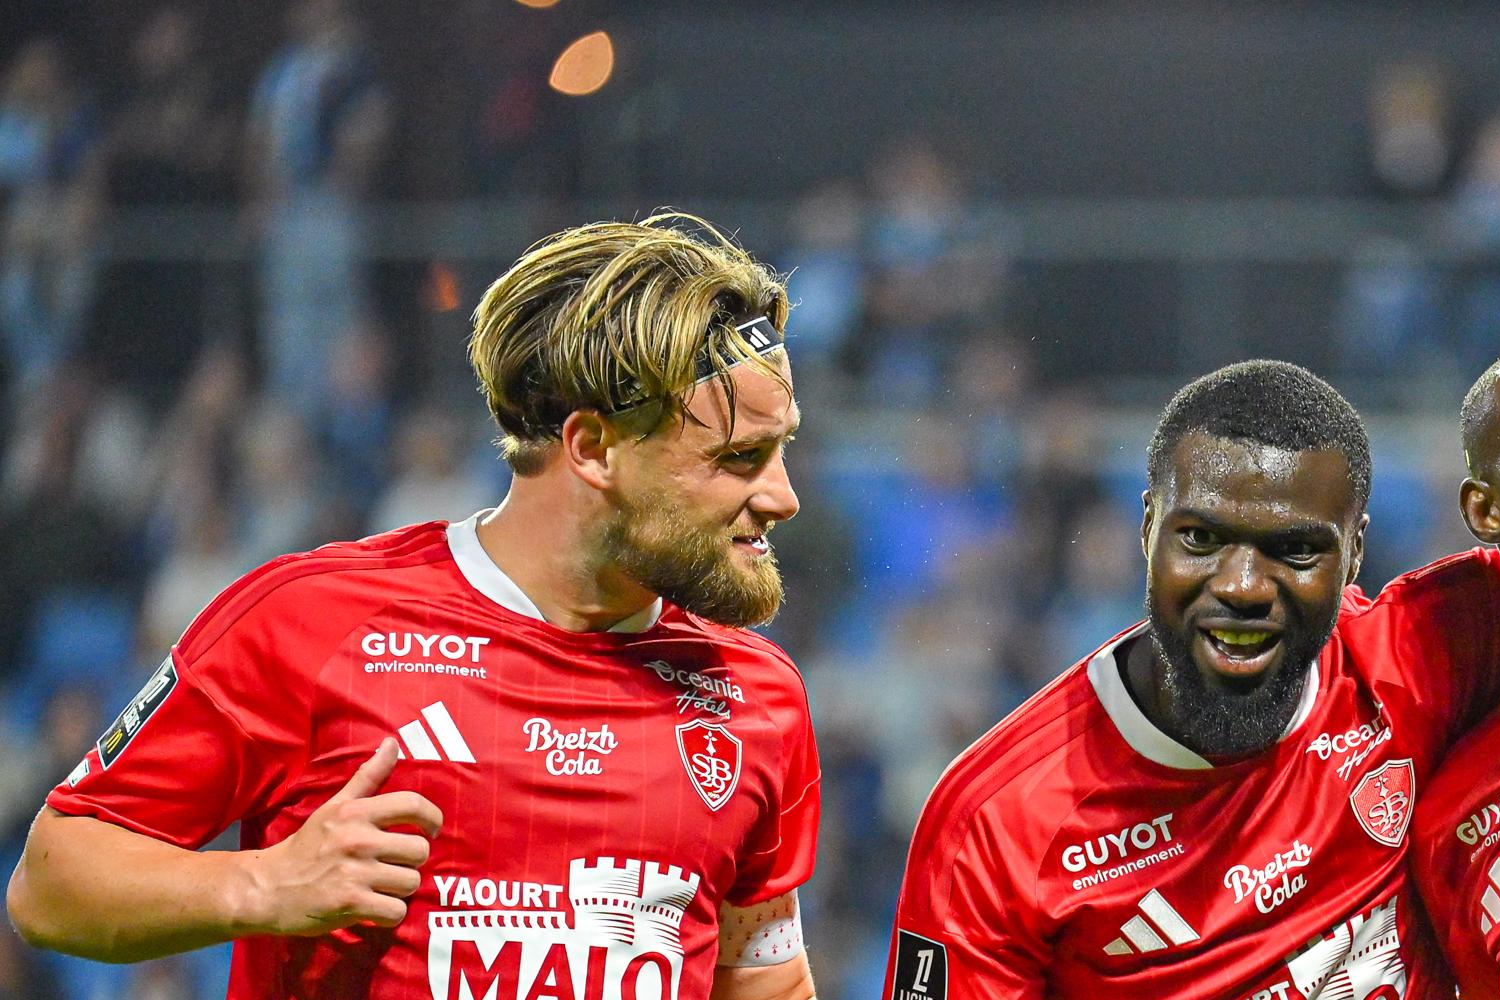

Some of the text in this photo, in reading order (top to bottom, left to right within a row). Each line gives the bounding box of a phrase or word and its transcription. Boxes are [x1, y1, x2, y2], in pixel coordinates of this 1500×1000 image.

[361, 632, 491, 662] GUYOT
[364, 660, 487, 679] environnement
[643, 660, 745, 703] Oceania
[676, 691, 731, 719] Hotels
[523, 718, 618, 754] Breizh
[546, 750, 602, 775] Cola
[692, 753, 732, 781] SB
[1062, 813, 1173, 872] GUYOT
[1072, 842, 1184, 890] environnement
[1224, 839, 1312, 904] Breizh
[433, 876, 563, 908] YAOURT
[1255, 873, 1307, 913] Cola
